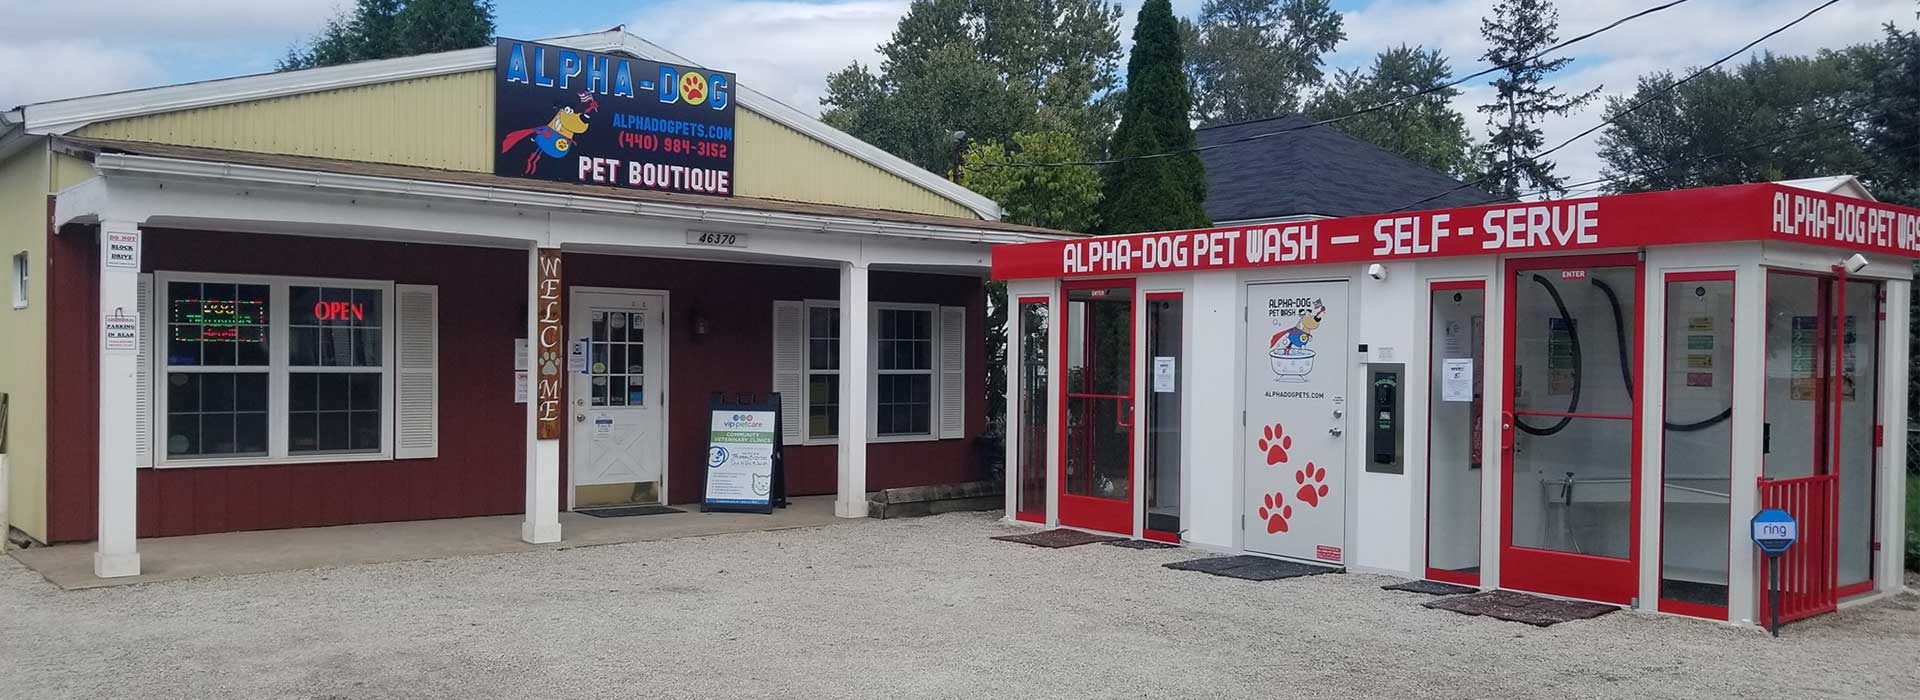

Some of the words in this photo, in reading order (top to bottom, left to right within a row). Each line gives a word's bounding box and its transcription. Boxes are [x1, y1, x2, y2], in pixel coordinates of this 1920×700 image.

[507, 42, 728, 111] ALPHA-DOG
[613, 113, 732, 141] ALPHADOGPETS.COM
[618, 131, 658, 151] (440)
[664, 137, 727, 159] 984-3152
[578, 155, 620, 183] PET
[629, 161, 729, 194] BOUTIQUE
[1772, 191, 1866, 244] ALPHA-DOG
[1867, 207, 1895, 248] PET
[699, 233, 736, 245] 46370
[1063, 234, 1188, 274] ALPHA-DOG
[1193, 231, 1240, 266] PET
[1246, 224, 1318, 264] WASH
[1562, 270, 1585, 278] ENTER
[314, 301, 364, 321] OPEN
[1268, 298, 1311, 308] ALPHA-DOG
[1268, 309, 1280, 317] PET
[539, 256, 561, 421] WELCME
[1265, 391, 1324, 399] ALPHADOGPETS.COM
[1763, 523, 1787, 537] ring
